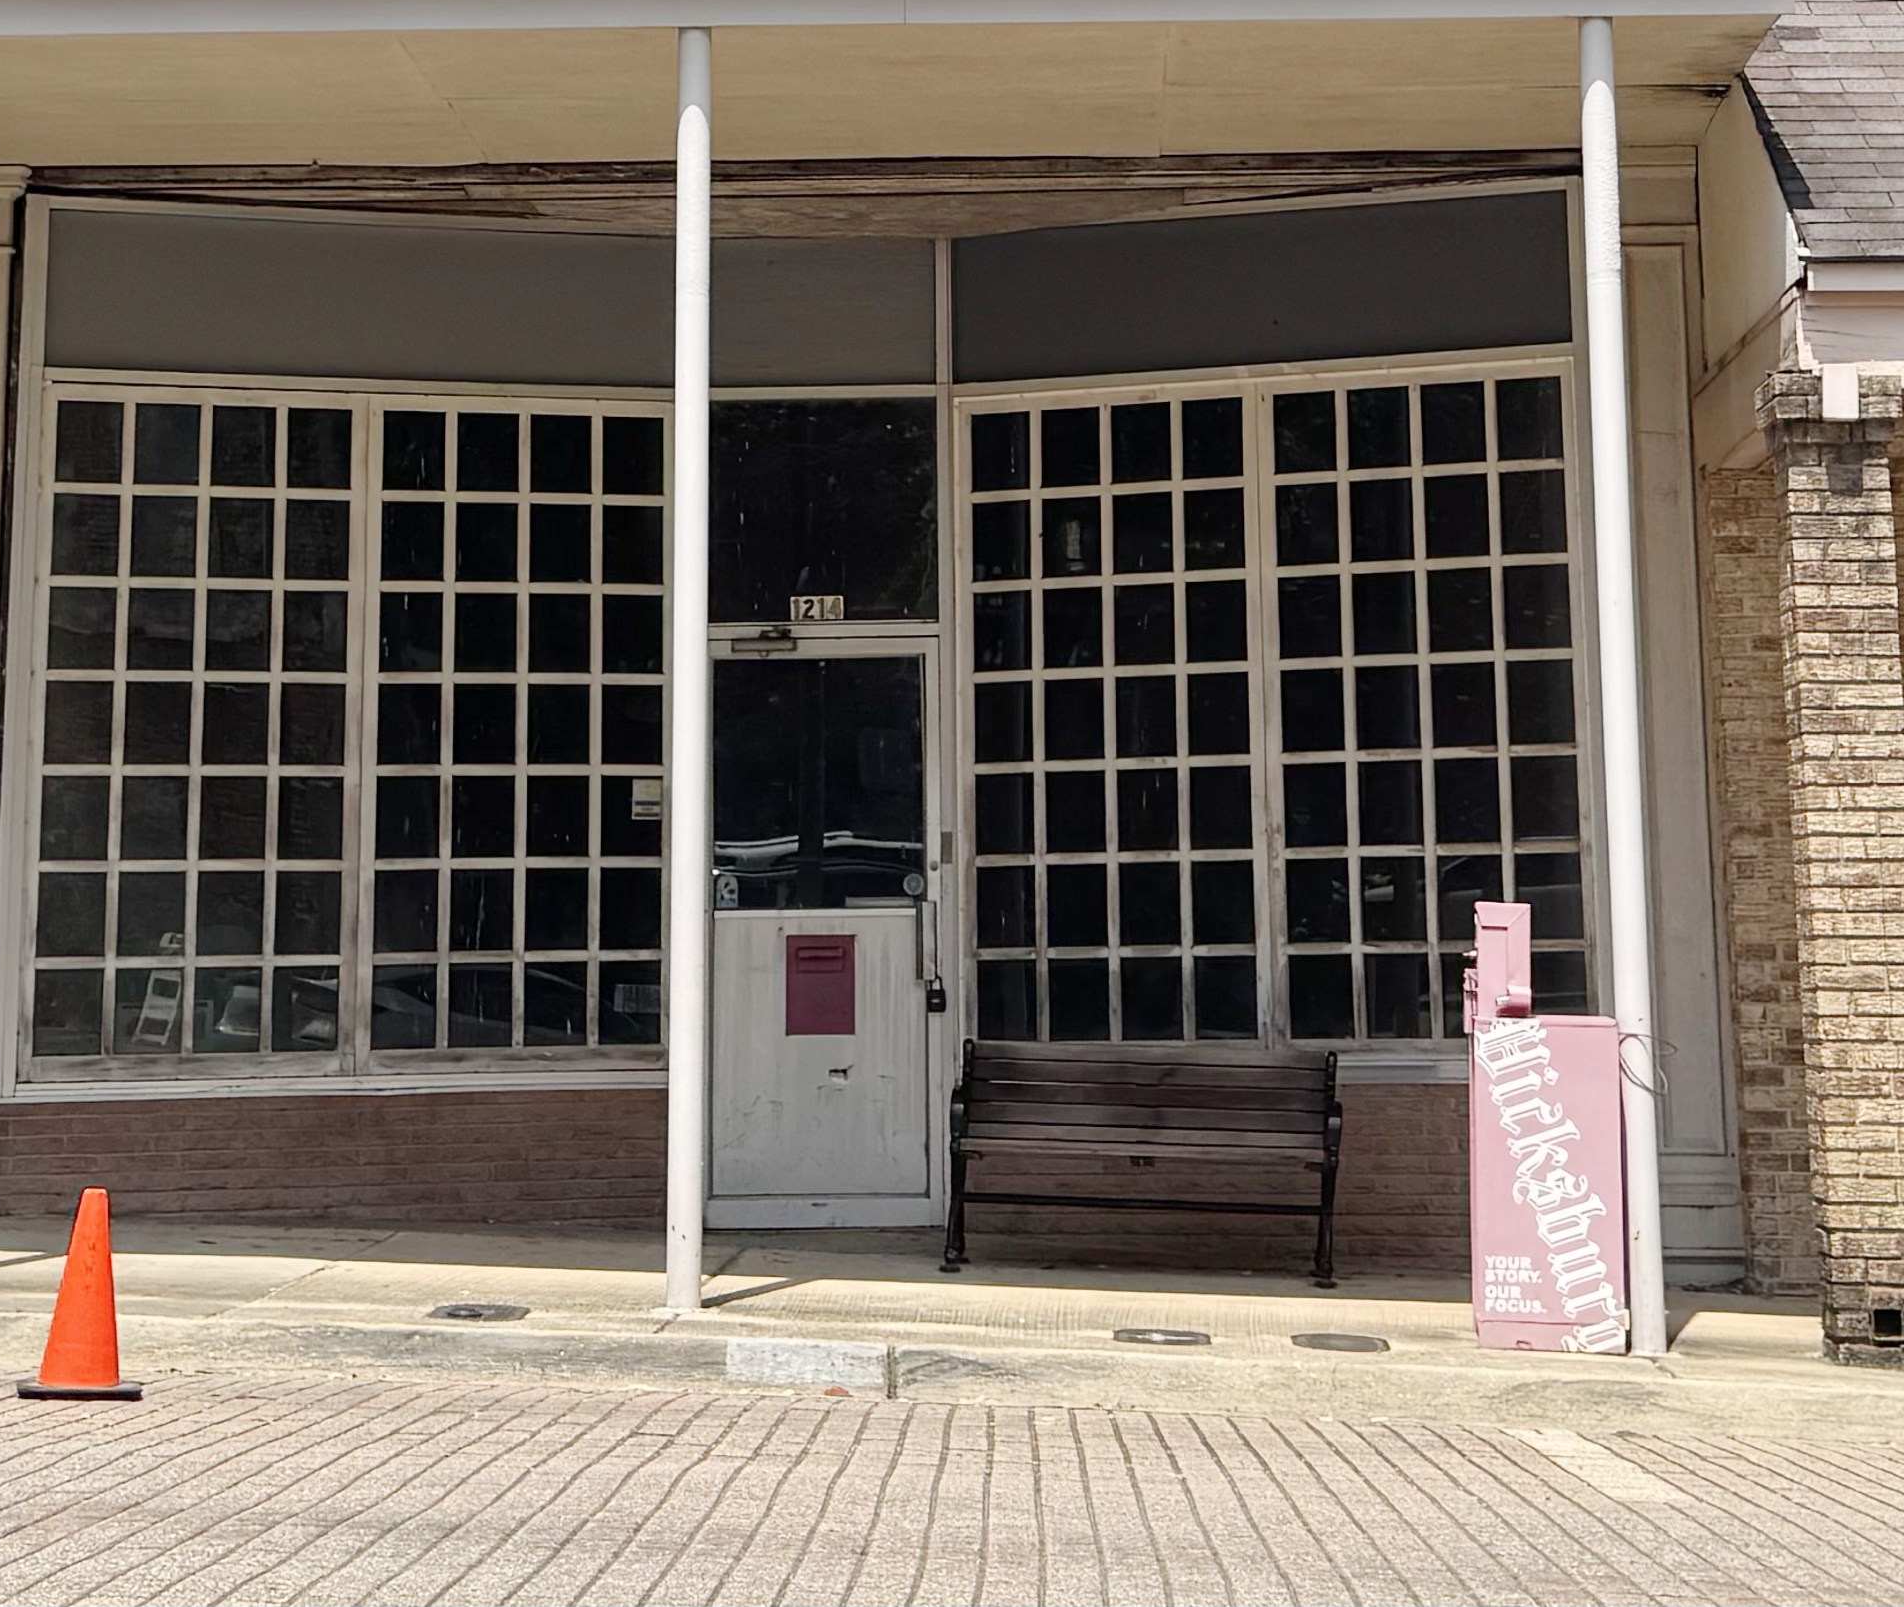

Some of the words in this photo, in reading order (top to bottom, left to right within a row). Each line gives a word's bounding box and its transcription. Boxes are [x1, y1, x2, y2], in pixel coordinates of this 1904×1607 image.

[792, 597, 842, 621] 1214
[1484, 1254, 1532, 1269] YOUR
[1484, 1269, 1543, 1284] STORY.
[1484, 1284, 1522, 1299] OUR
[1484, 1298, 1548, 1314] FOCUS.
